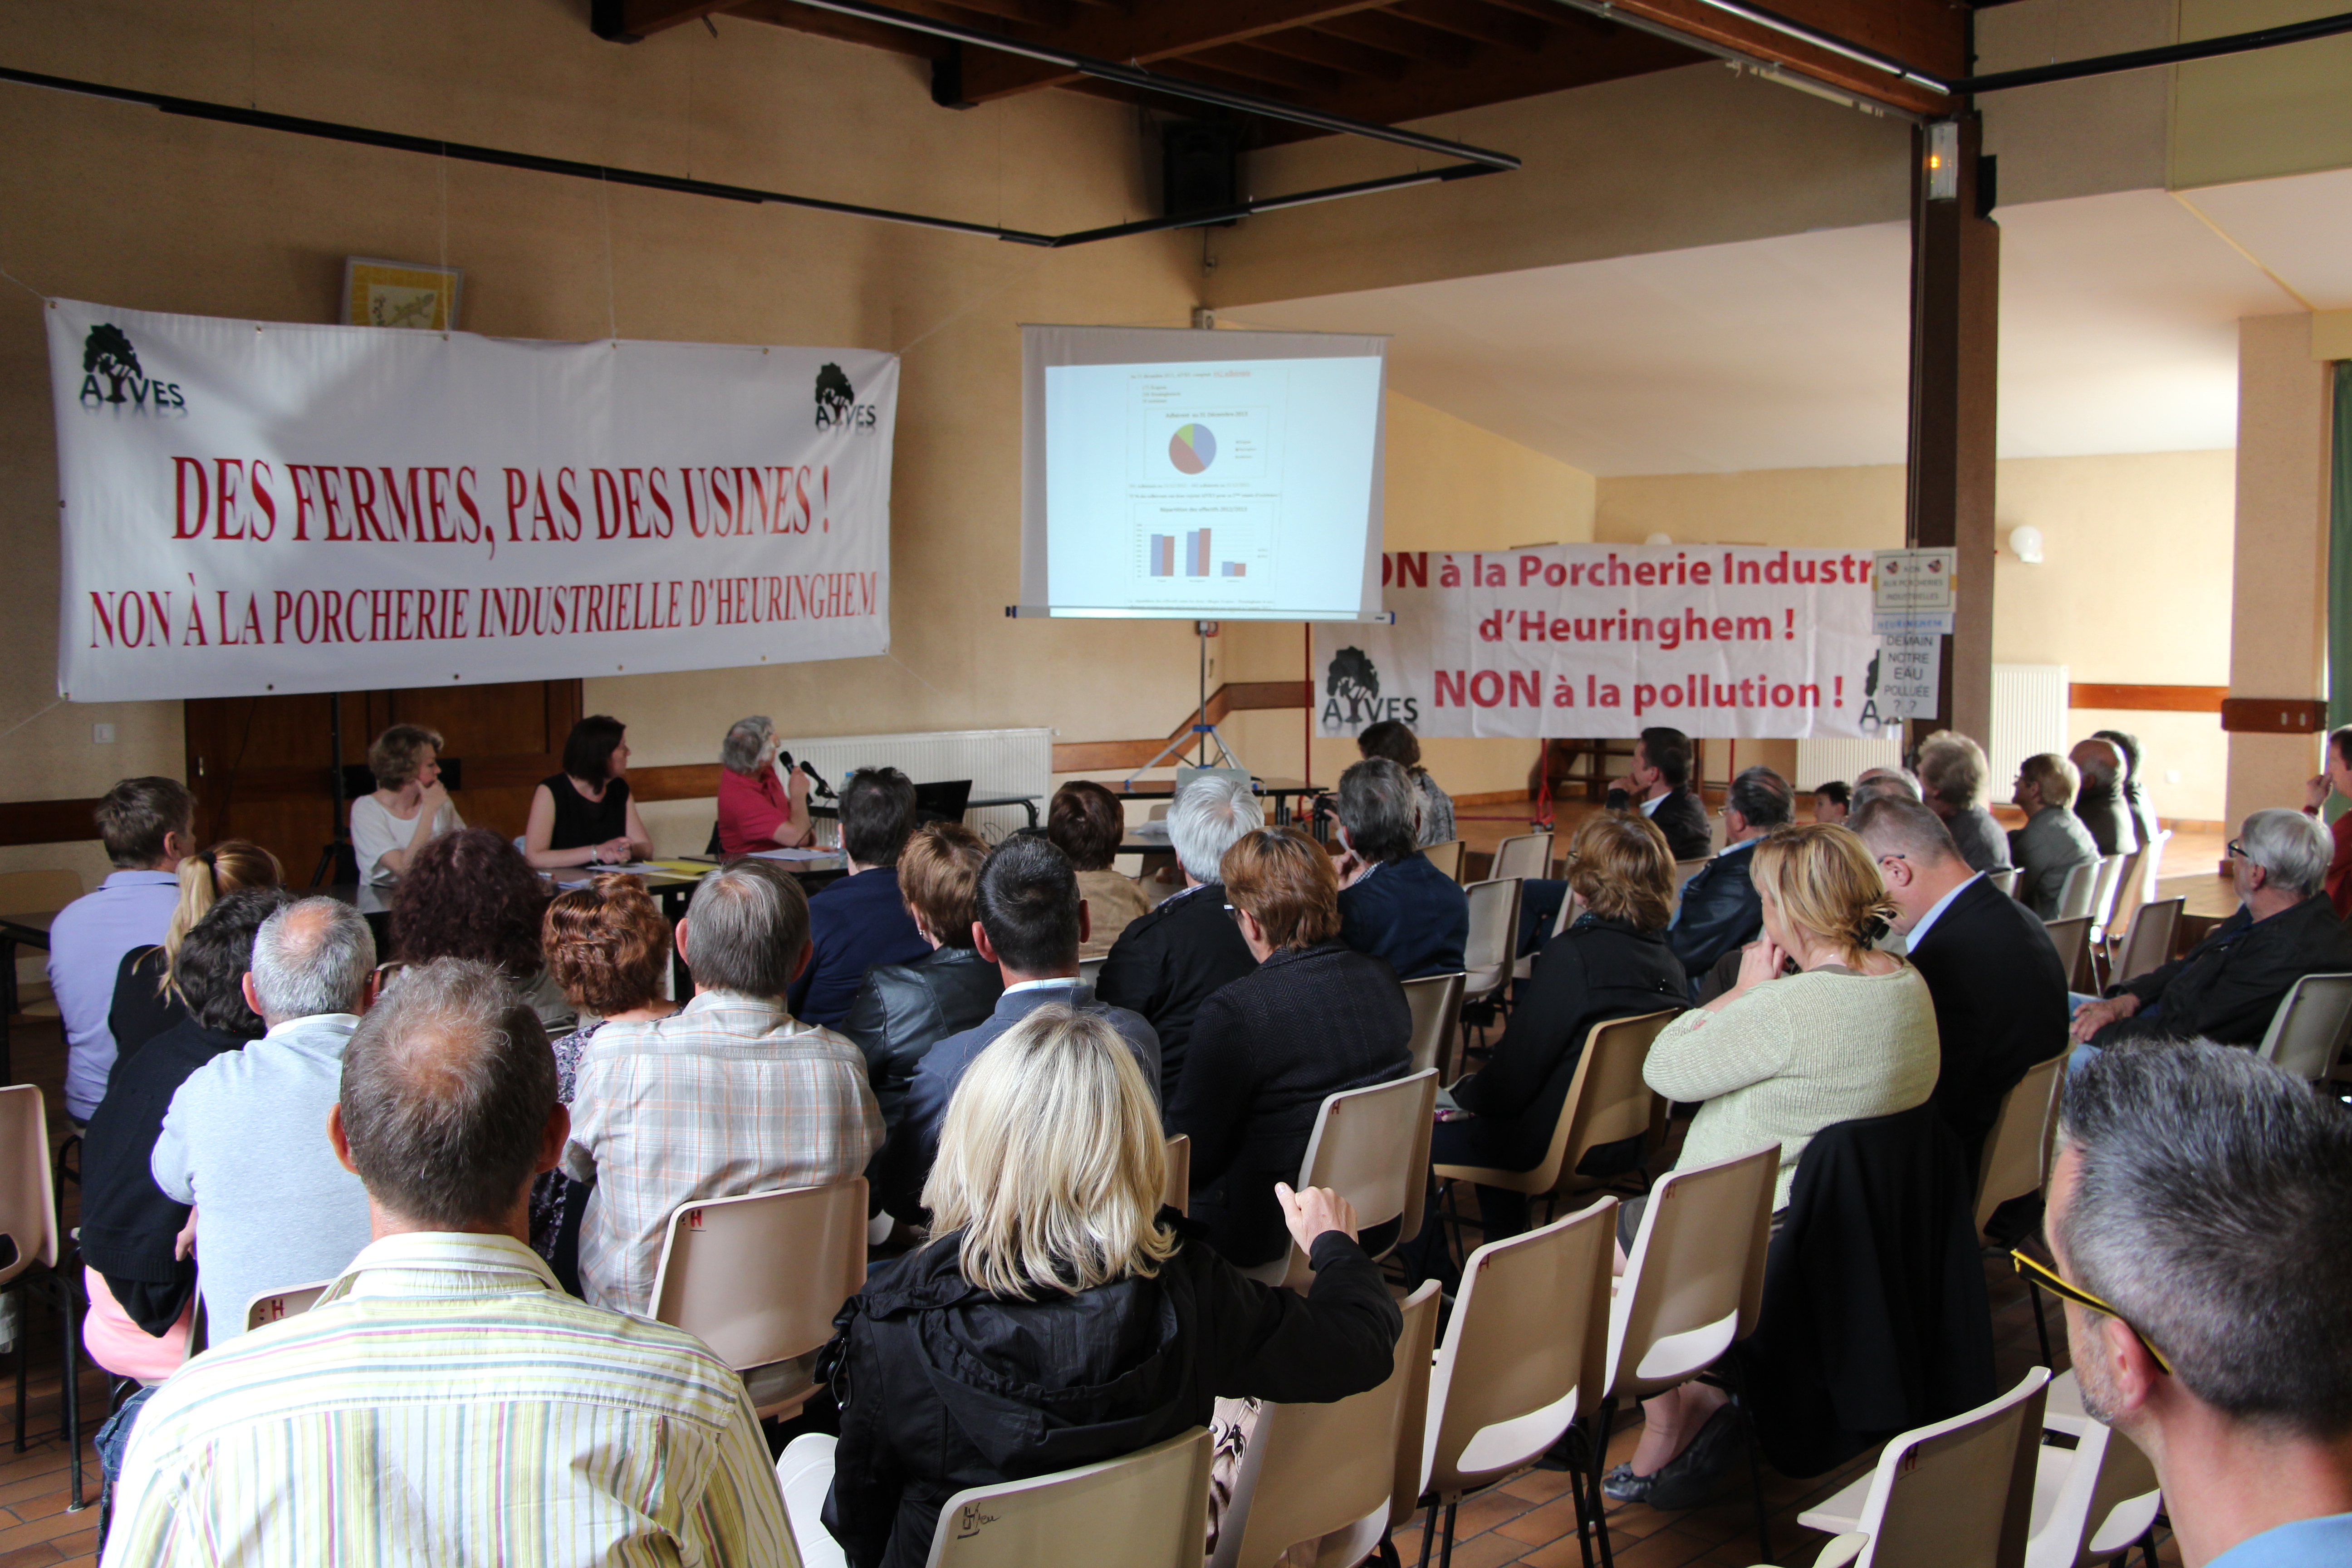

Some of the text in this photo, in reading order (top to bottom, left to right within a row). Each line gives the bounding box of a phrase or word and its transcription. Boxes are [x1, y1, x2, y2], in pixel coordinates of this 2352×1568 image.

[172, 456, 829, 560] DES FERMES, PAS DES USINES !
[1440, 554, 1461, 588] à
[1474, 554, 1506, 588] la
[1519, 552, 1712, 588] Porcherie
[89, 571, 878, 648] NON À LA PORCHERIE INDUSTRIELLE D'HEURINGHEM
[1478, 607, 1796, 652] d'Heuringhem !
[1886, 636, 1933, 647] DEMAIN
[1888, 652, 1931, 664] NOTRE
[1894, 666, 1924, 680] EAU
[1434, 669, 1542, 708] NON
[1553, 674, 1575, 708] à
[1587, 674, 1622, 708] la
[1633, 673, 1822, 718] pollution
[1833, 675, 1844, 709] !
[690, 1209, 702, 1227] H
[271, 1298, 284, 1321] H
